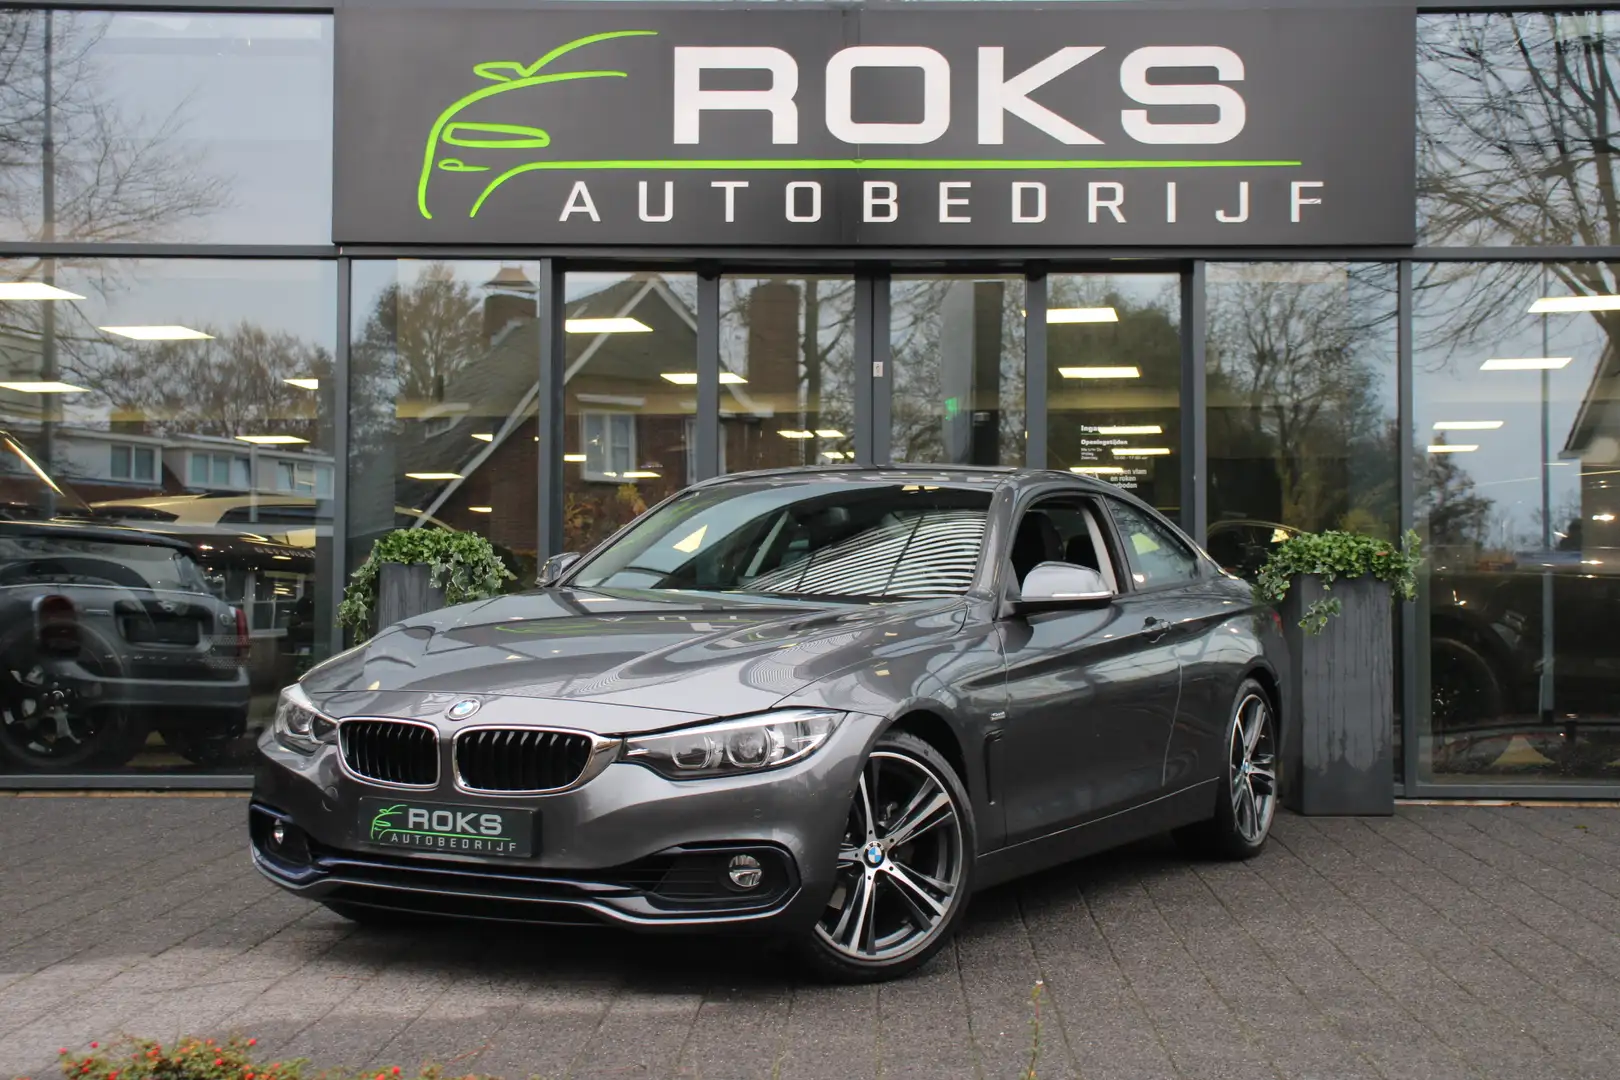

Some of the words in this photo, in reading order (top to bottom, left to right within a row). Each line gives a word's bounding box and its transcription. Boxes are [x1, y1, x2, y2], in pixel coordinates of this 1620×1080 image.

[673, 46, 1246, 145] ROKS
[558, 181, 1324, 224] AUTOBEDRIJF
[408, 808, 502, 836] ROKS
[391, 833, 516, 852] AUTOBEDRIJF
